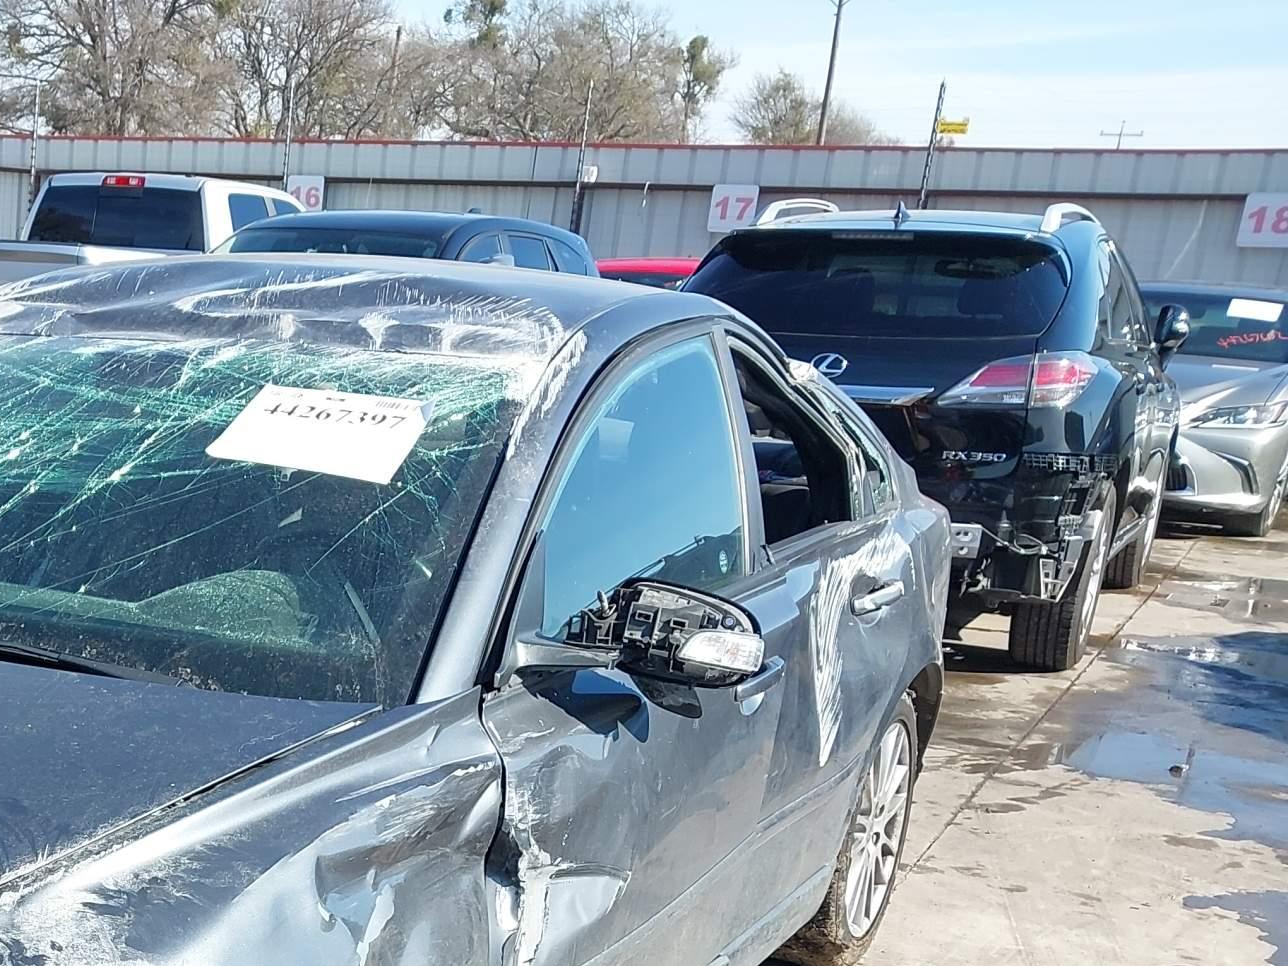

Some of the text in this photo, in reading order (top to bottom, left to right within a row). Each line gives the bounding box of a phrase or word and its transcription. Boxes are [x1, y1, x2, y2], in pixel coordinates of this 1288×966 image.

[290, 185, 321, 208] 16
[714, 195, 755, 221] 17
[1247, 205, 1288, 235] 18
[263, 402, 408, 429] 44267397
[941, 450, 1007, 463] RX 350
